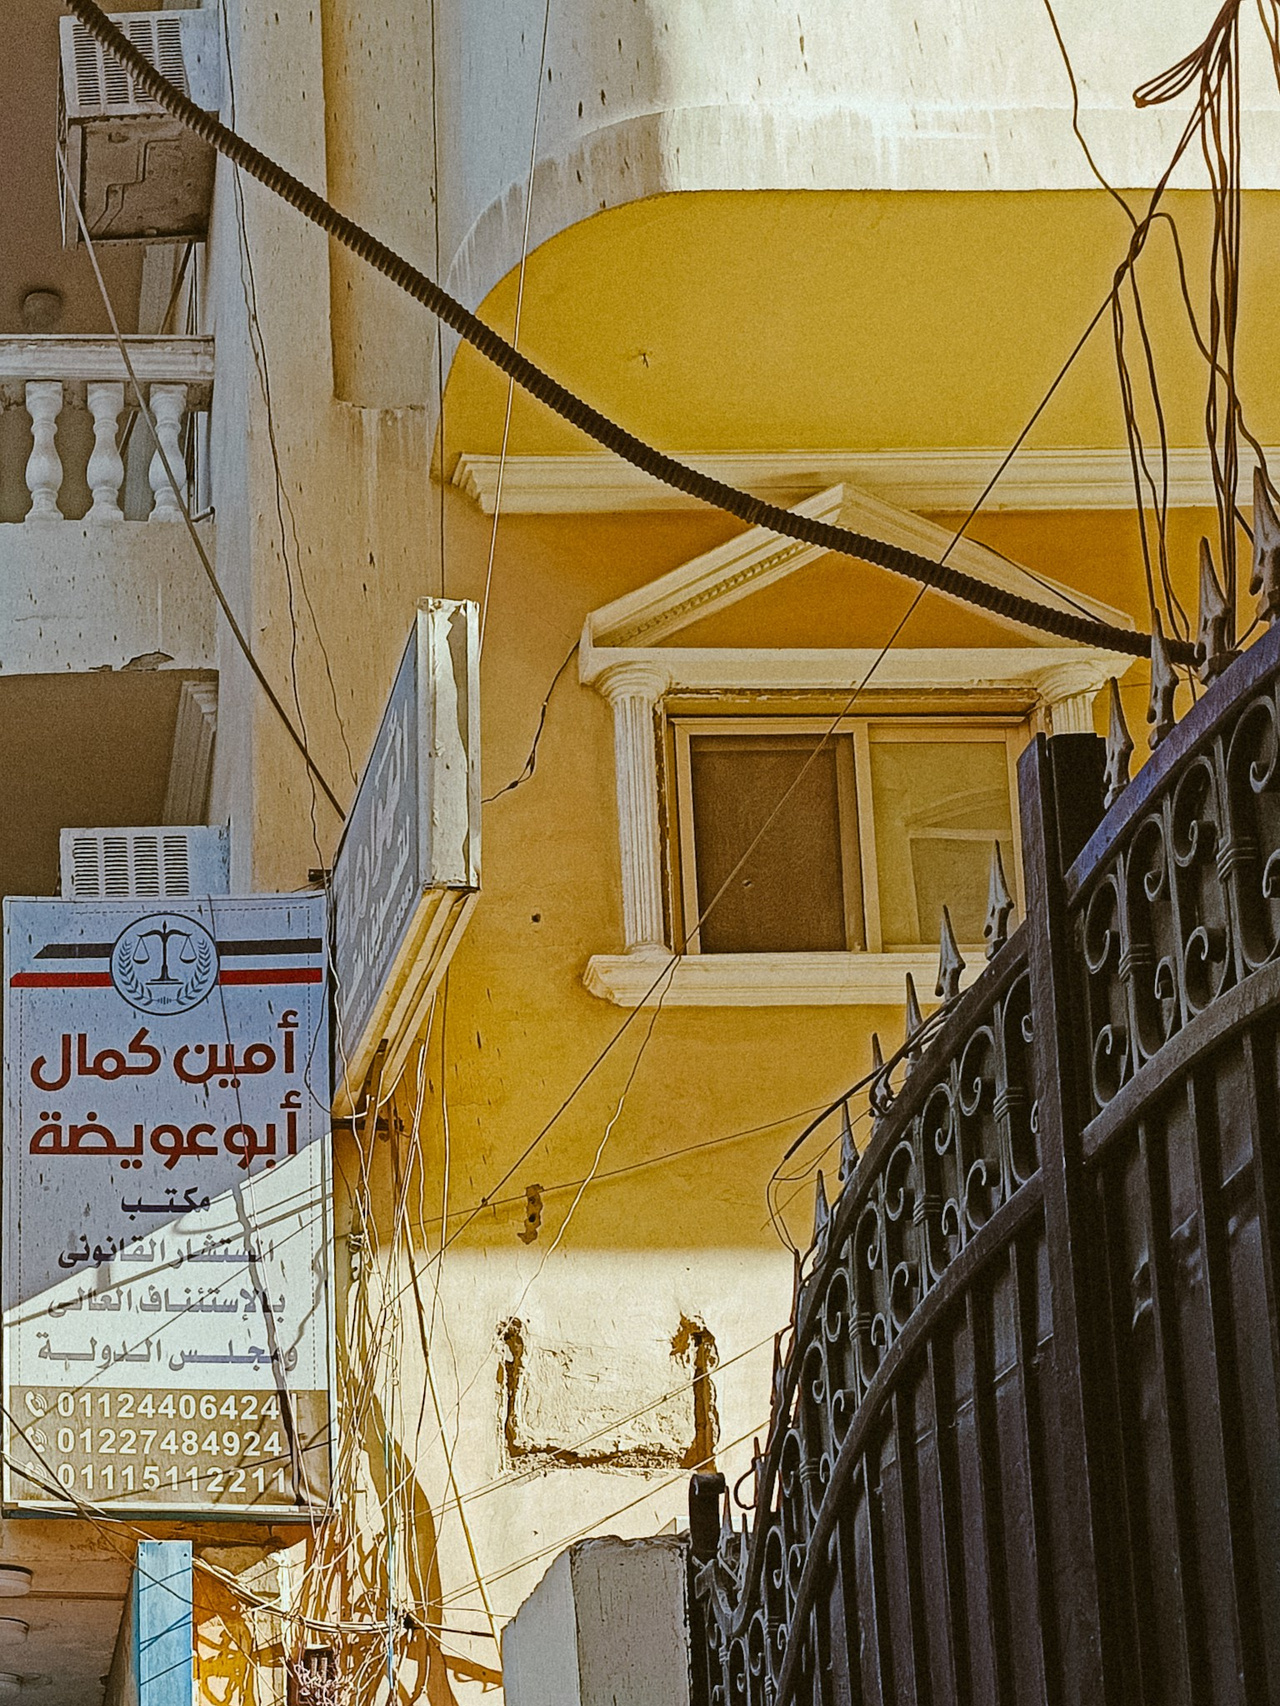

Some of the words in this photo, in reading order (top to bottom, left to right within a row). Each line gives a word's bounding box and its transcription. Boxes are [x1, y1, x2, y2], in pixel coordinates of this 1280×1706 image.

[30, 1027, 161, 1092] كمال
[173, 1009, 299, 1088] أمين
[121, 1186, 211, 1221] مكتب
[36, 1332, 161, 1369] الدولة
[57, 1391, 280, 1421] 01124406424
[57, 1428, 282, 1457] 01227484924
[57, 1463, 286, 1493] 01115112211
